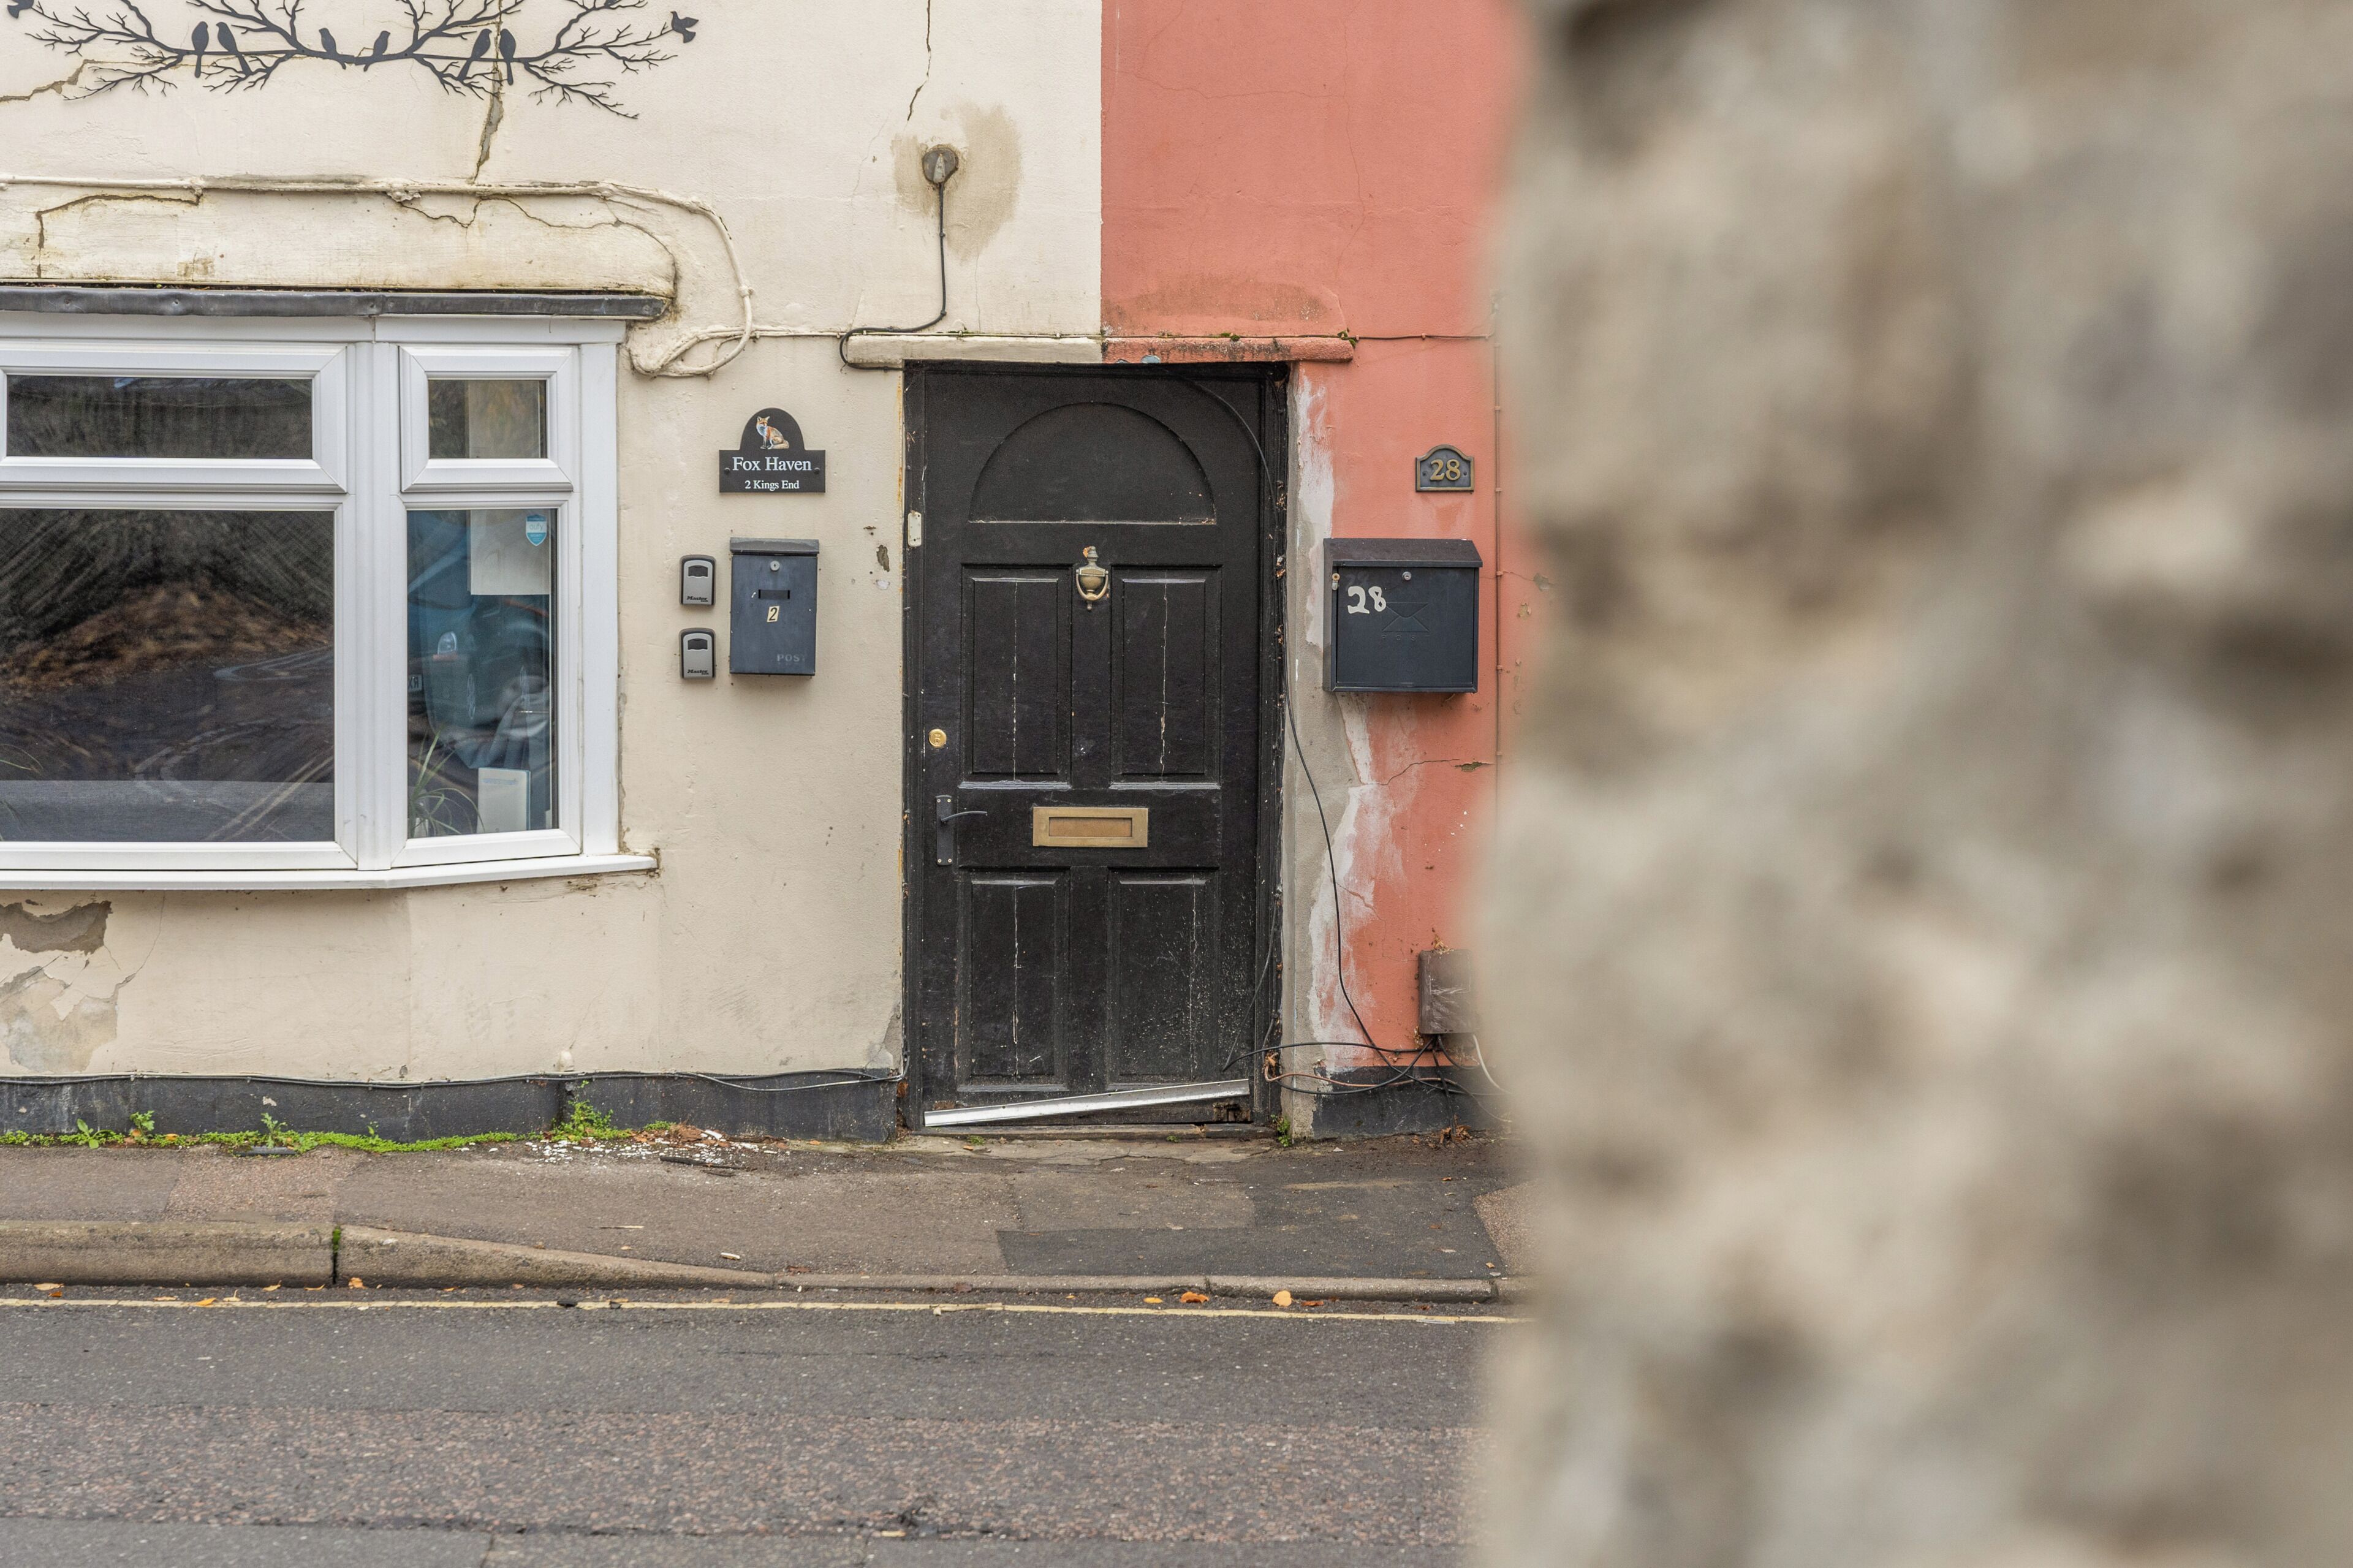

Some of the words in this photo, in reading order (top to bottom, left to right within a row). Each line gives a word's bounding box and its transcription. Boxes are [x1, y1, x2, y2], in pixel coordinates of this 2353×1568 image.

[732, 456, 761, 471] Fox
[765, 456, 812, 471] Haven
[1430, 459, 1461, 481] 28
[745, 480, 751, 489] 2
[753, 480, 779, 491] Kings
[781, 480, 800, 489] End
[1347, 586, 1386, 614] 28
[768, 607, 778, 621] 2
